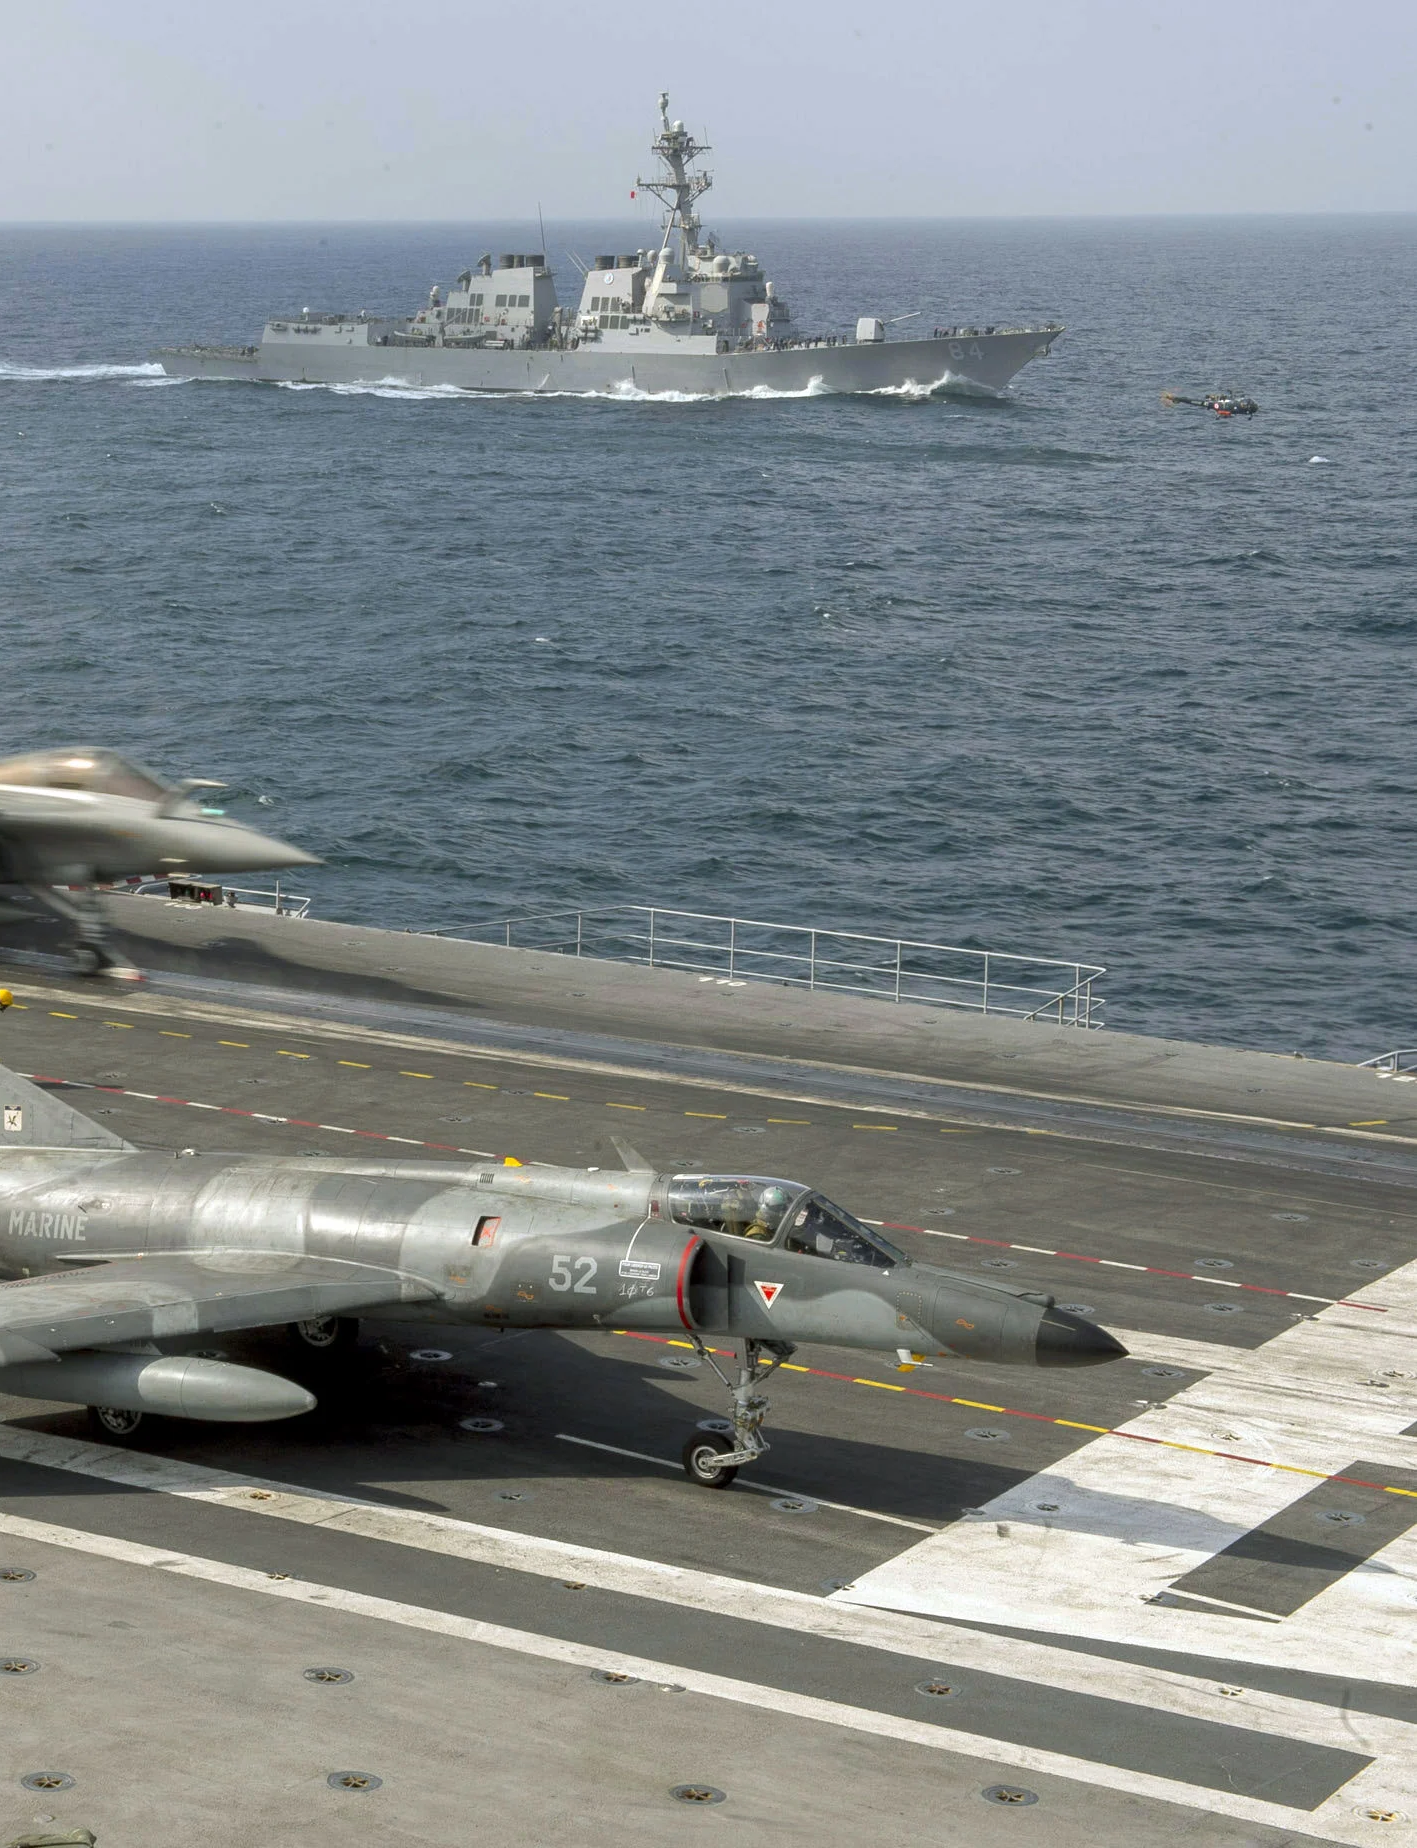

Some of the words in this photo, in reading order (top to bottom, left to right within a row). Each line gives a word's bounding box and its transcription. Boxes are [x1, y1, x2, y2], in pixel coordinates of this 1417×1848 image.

[948, 341, 984, 360] 84
[8, 1209, 89, 1241] MARINE
[548, 1254, 598, 1294] 52
